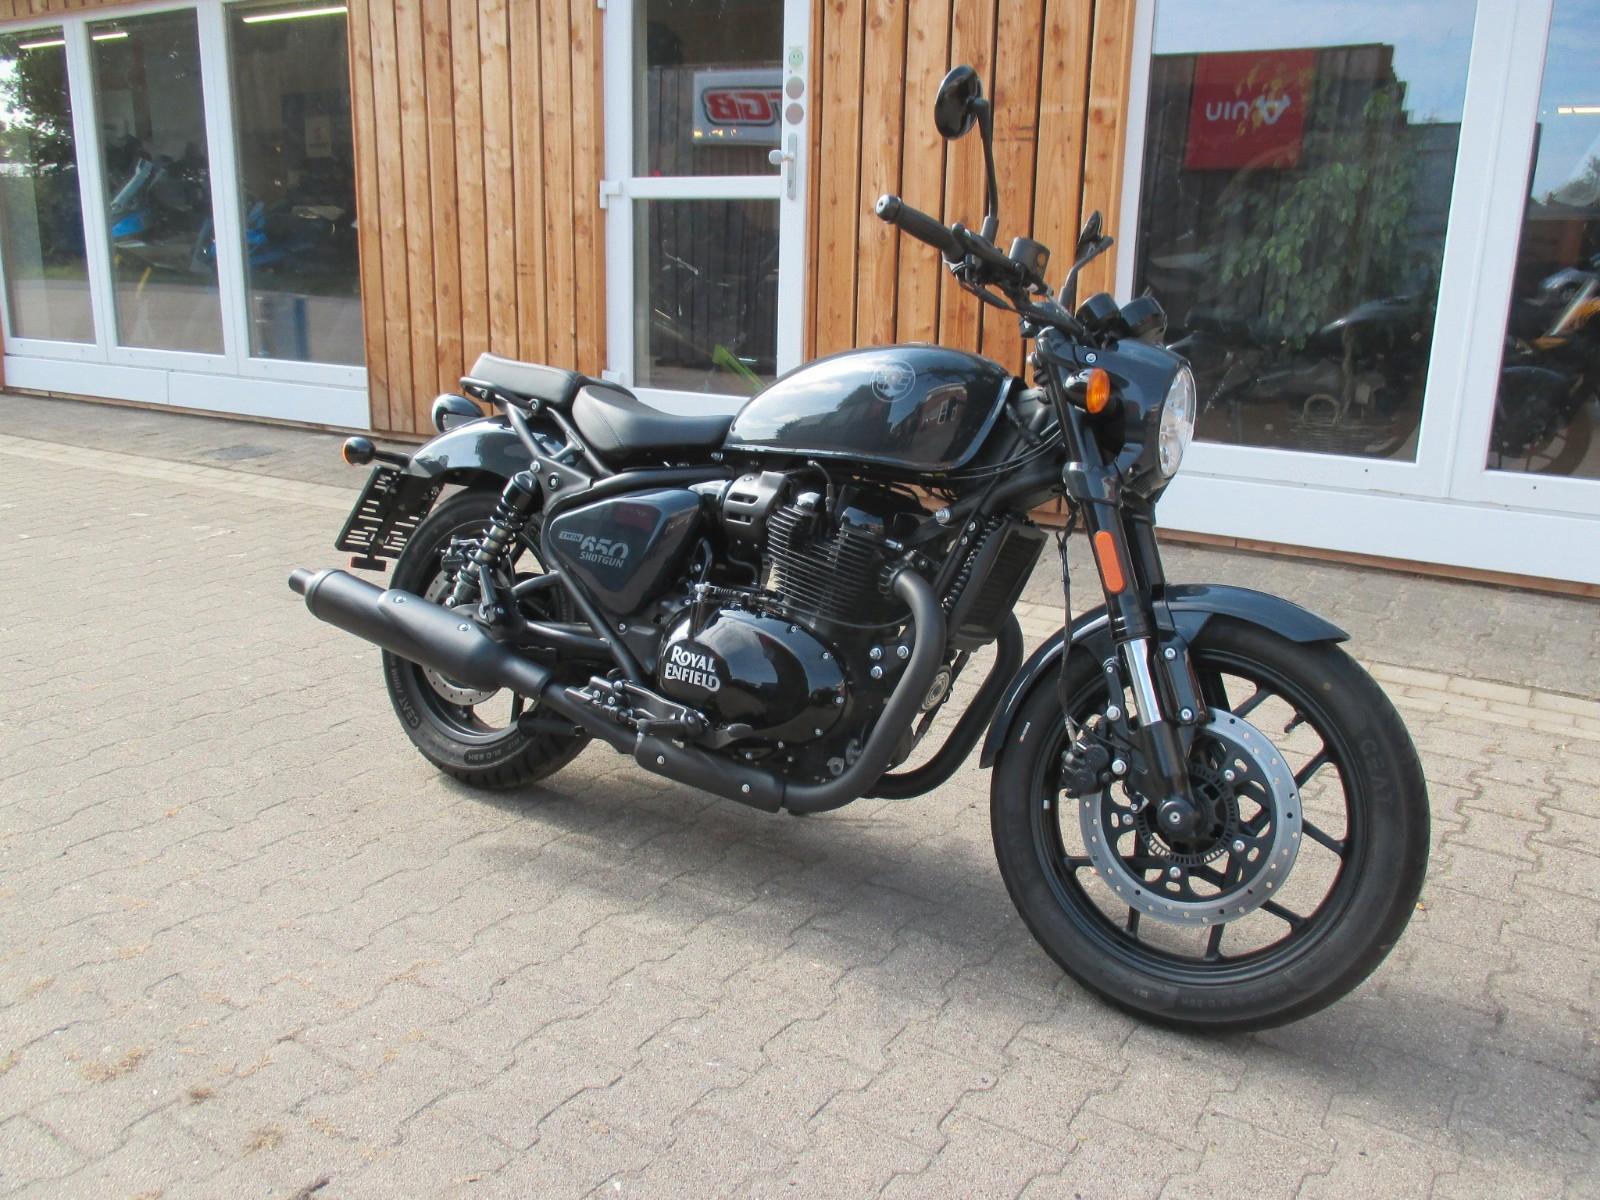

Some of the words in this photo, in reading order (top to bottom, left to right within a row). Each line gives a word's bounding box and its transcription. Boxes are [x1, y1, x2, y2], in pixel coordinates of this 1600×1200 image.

[580, 551, 624, 568] SHOTGUN
[581, 536, 628, 559] 650
[671, 645, 716, 672] ROYAL
[665, 663, 720, 691] ENFIELD
